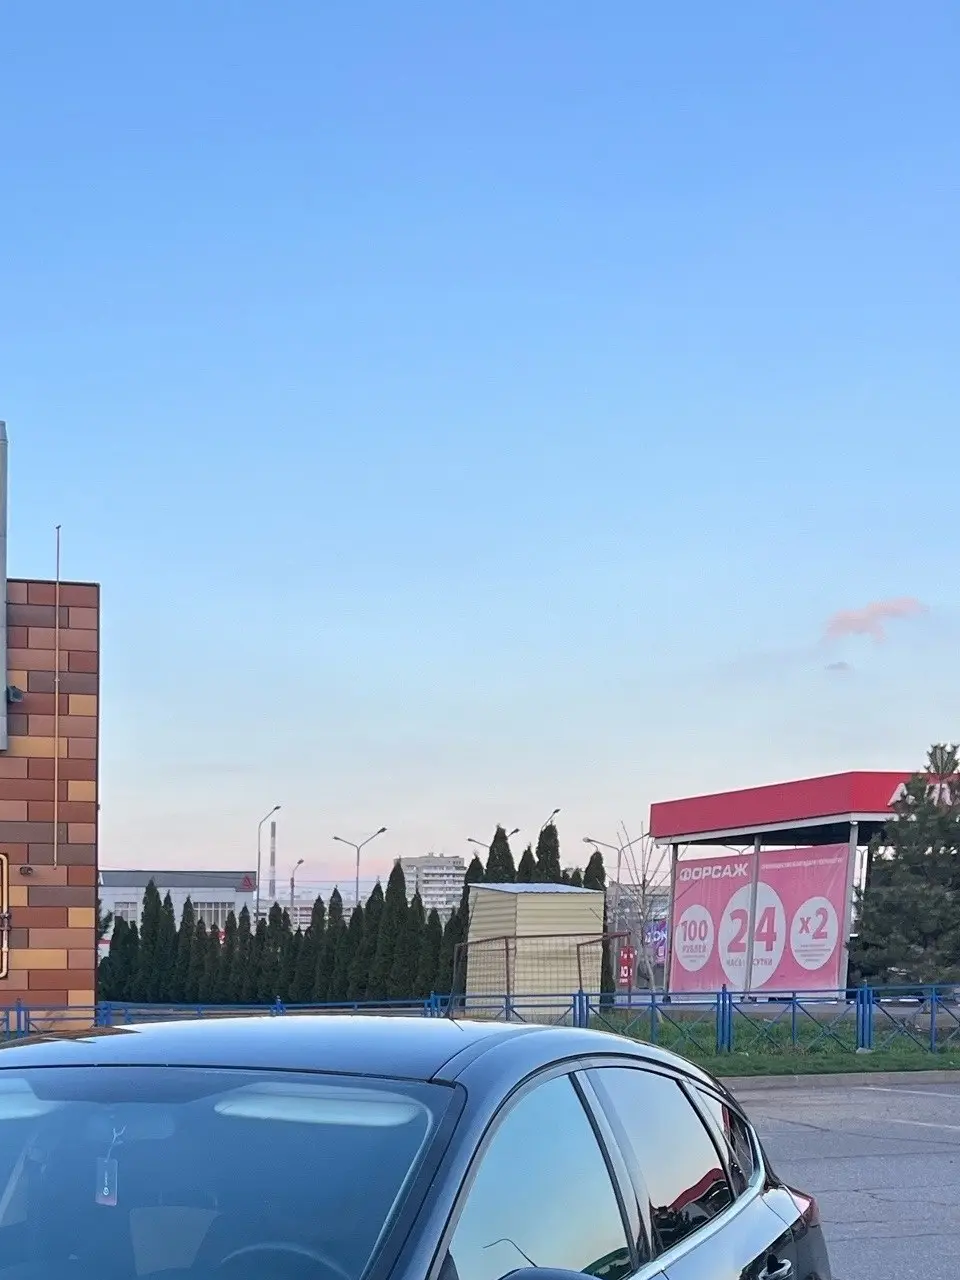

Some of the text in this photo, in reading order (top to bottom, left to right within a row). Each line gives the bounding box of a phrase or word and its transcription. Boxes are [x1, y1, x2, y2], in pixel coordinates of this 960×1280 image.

[679, 863, 749, 881] ФОРСАЖ
[681, 920, 708, 941] 100
[727, 906, 777, 953] 24
